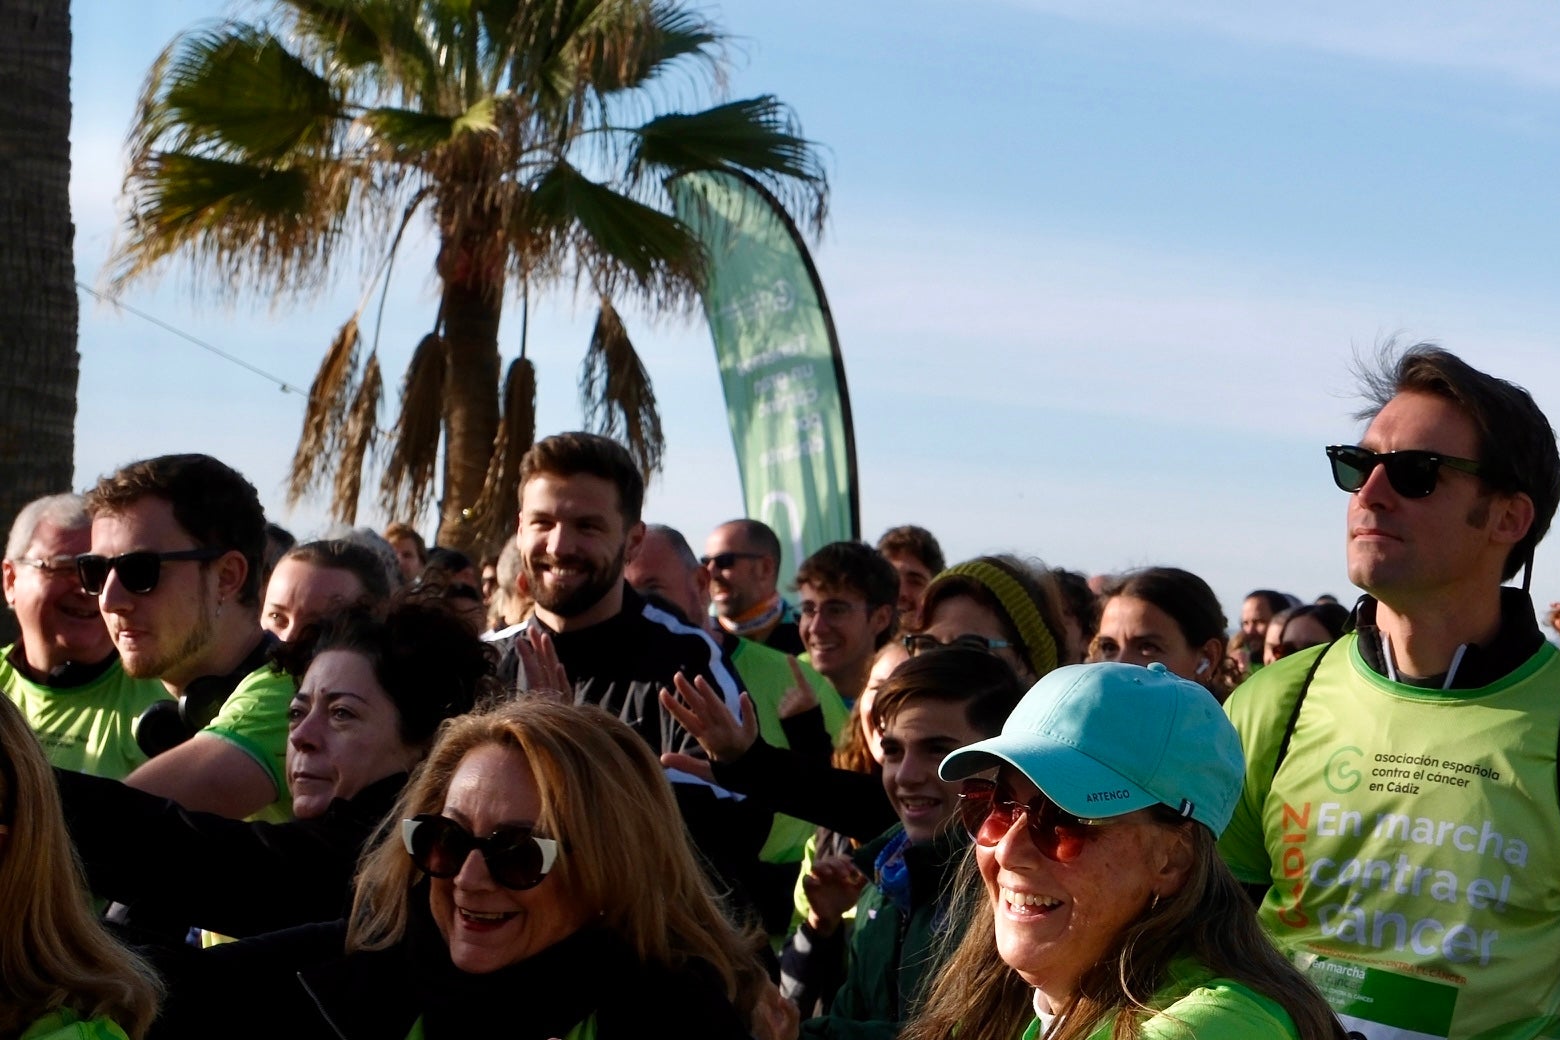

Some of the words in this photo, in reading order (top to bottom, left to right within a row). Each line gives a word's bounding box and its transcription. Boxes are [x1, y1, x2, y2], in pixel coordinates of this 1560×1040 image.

[1372, 767, 1411, 779] contra
[1413, 769, 1425, 780] el
[1426, 771, 1470, 789] cáncer
[1374, 753, 1439, 768] asociación
[1442, 759, 1501, 781] española
[1086, 789, 1130, 803] ARTENGO
[1369, 782, 1384, 792] en
[1386, 781, 1420, 795] Cádiz
[1317, 802, 1364, 837] En
[1374, 811, 1529, 868] marcha
[1309, 854, 1458, 904] contra
[1466, 874, 1512, 913] el
[1317, 892, 1499, 966] cáncer
[1327, 962, 1366, 980] marcha
